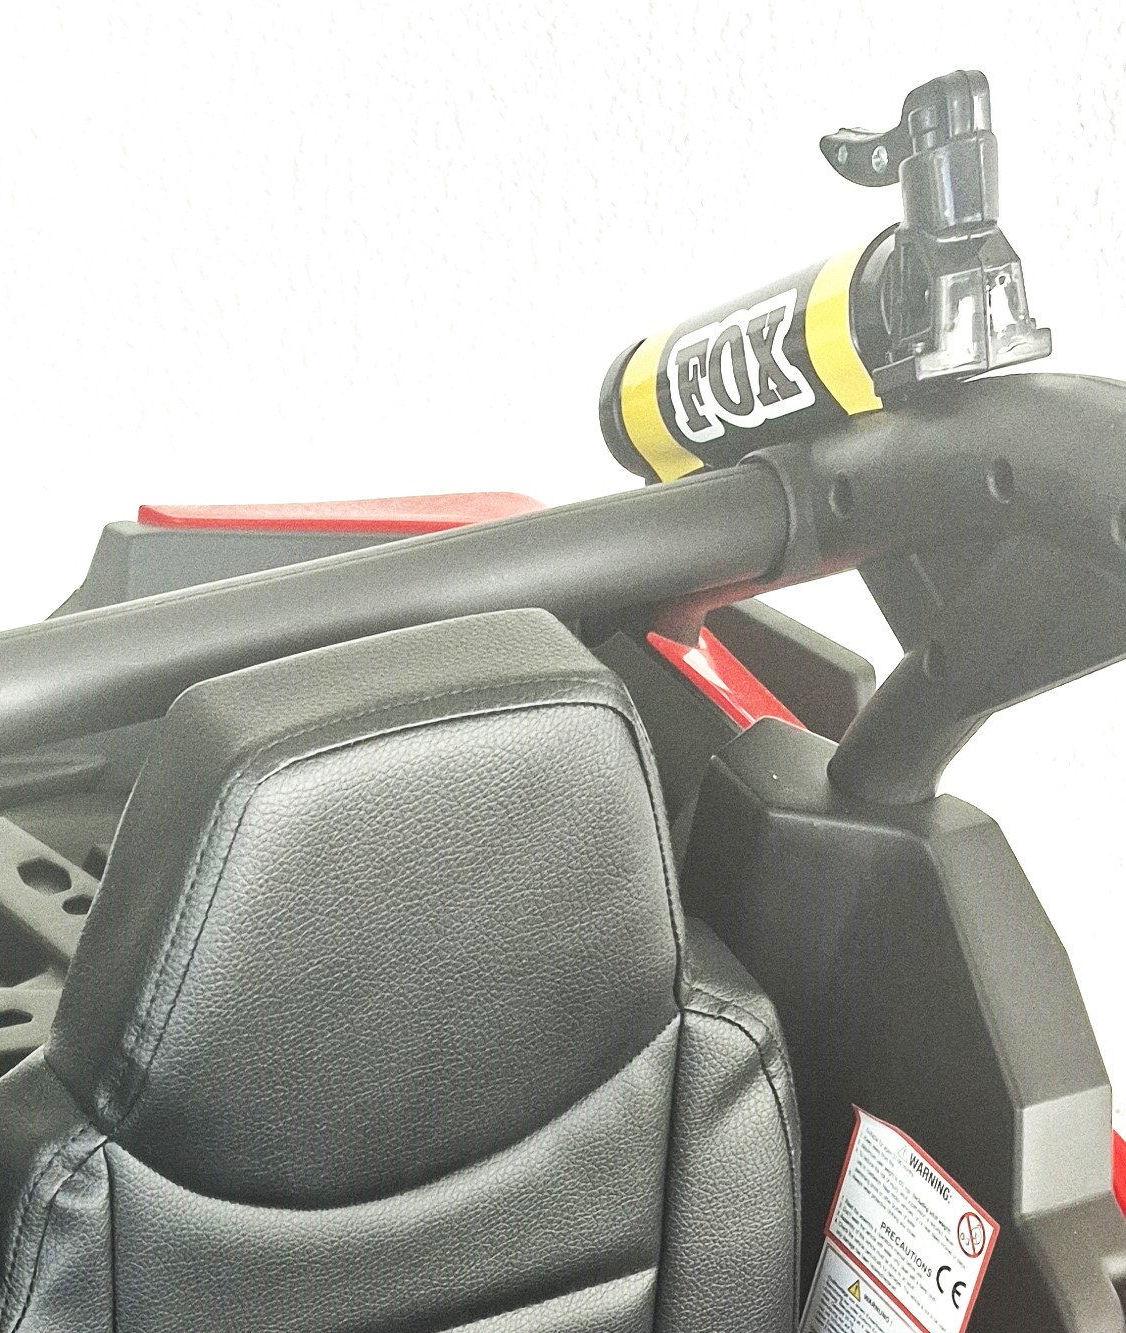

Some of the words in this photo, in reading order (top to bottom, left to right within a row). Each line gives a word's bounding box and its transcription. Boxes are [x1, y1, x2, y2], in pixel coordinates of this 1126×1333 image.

[673, 303, 805, 436] FOX
[909, 1152, 952, 1204] WARNING:
[880, 1221, 932, 1278] PRECAUTIONS
[936, 1265, 967, 1310] CE
